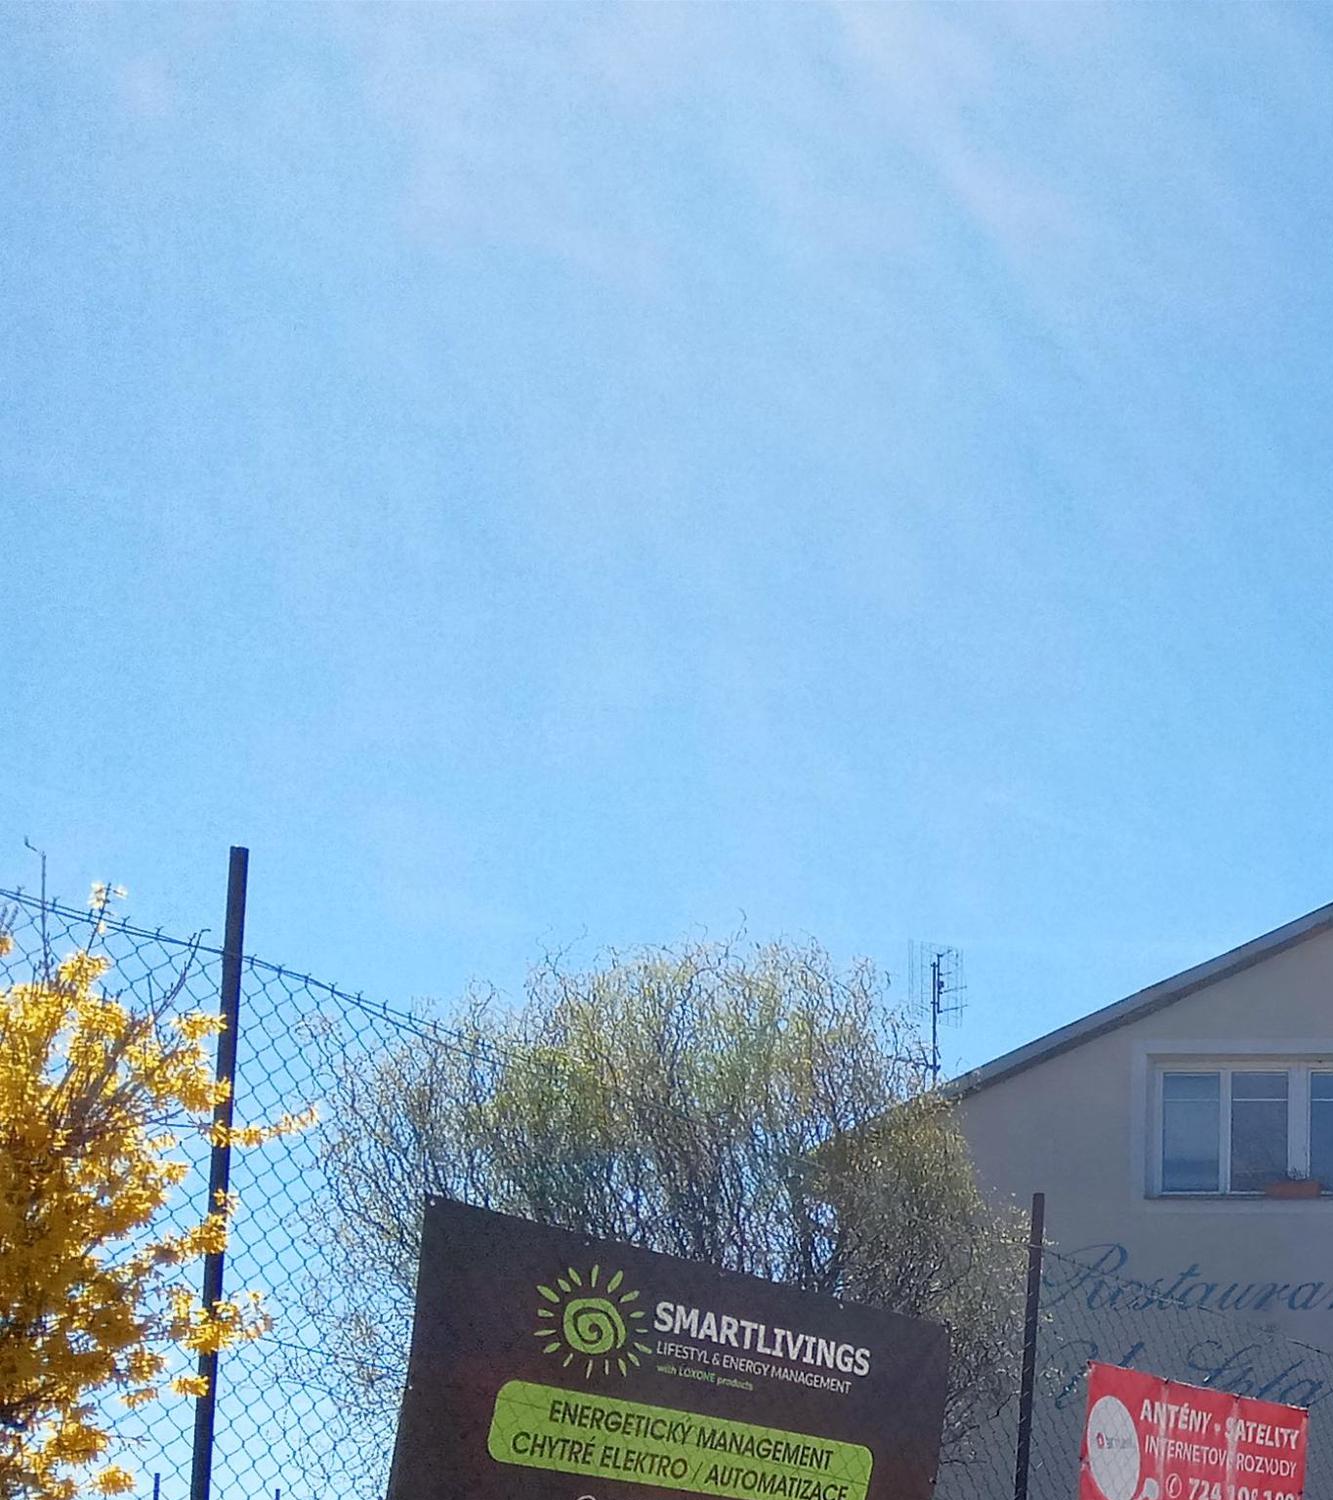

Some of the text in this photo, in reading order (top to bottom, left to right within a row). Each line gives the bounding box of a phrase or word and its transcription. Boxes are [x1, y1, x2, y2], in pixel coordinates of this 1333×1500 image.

[653, 1301, 872, 1377] SMARTLIVINGS
[656, 1340, 852, 1395] LIFESTYL & ENERGY MANAGEMENT
[677, 1365, 717, 1384] LOXONE
[715, 1376, 754, 1392] products
[549, 1399, 834, 1471] ENERGETICKÝ MANAGEMENT
[1140, 1398, 1212, 1434] ANTÉNY
[511, 1431, 596, 1466] CHYTRÉ
[599, 1445, 689, 1480] ELEKTRO
[690, 1462, 703, 1484] /
